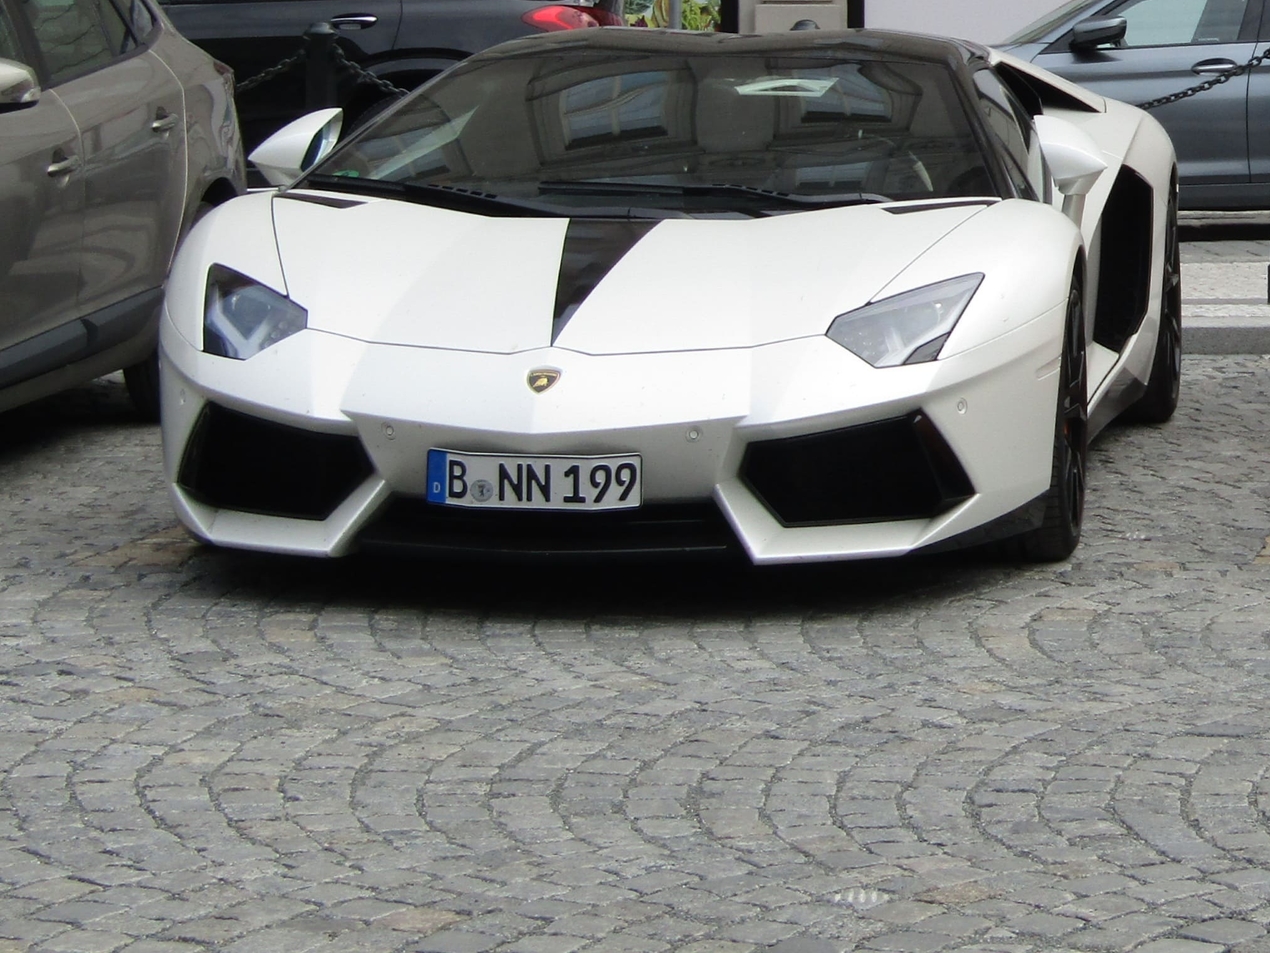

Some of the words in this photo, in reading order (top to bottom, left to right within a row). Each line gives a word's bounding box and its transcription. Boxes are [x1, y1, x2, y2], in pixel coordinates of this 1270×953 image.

[433, 481, 441, 494] D
[449, 459, 468, 499] B
[499, 462, 551, 503] NN
[563, 462, 637, 503] 199
